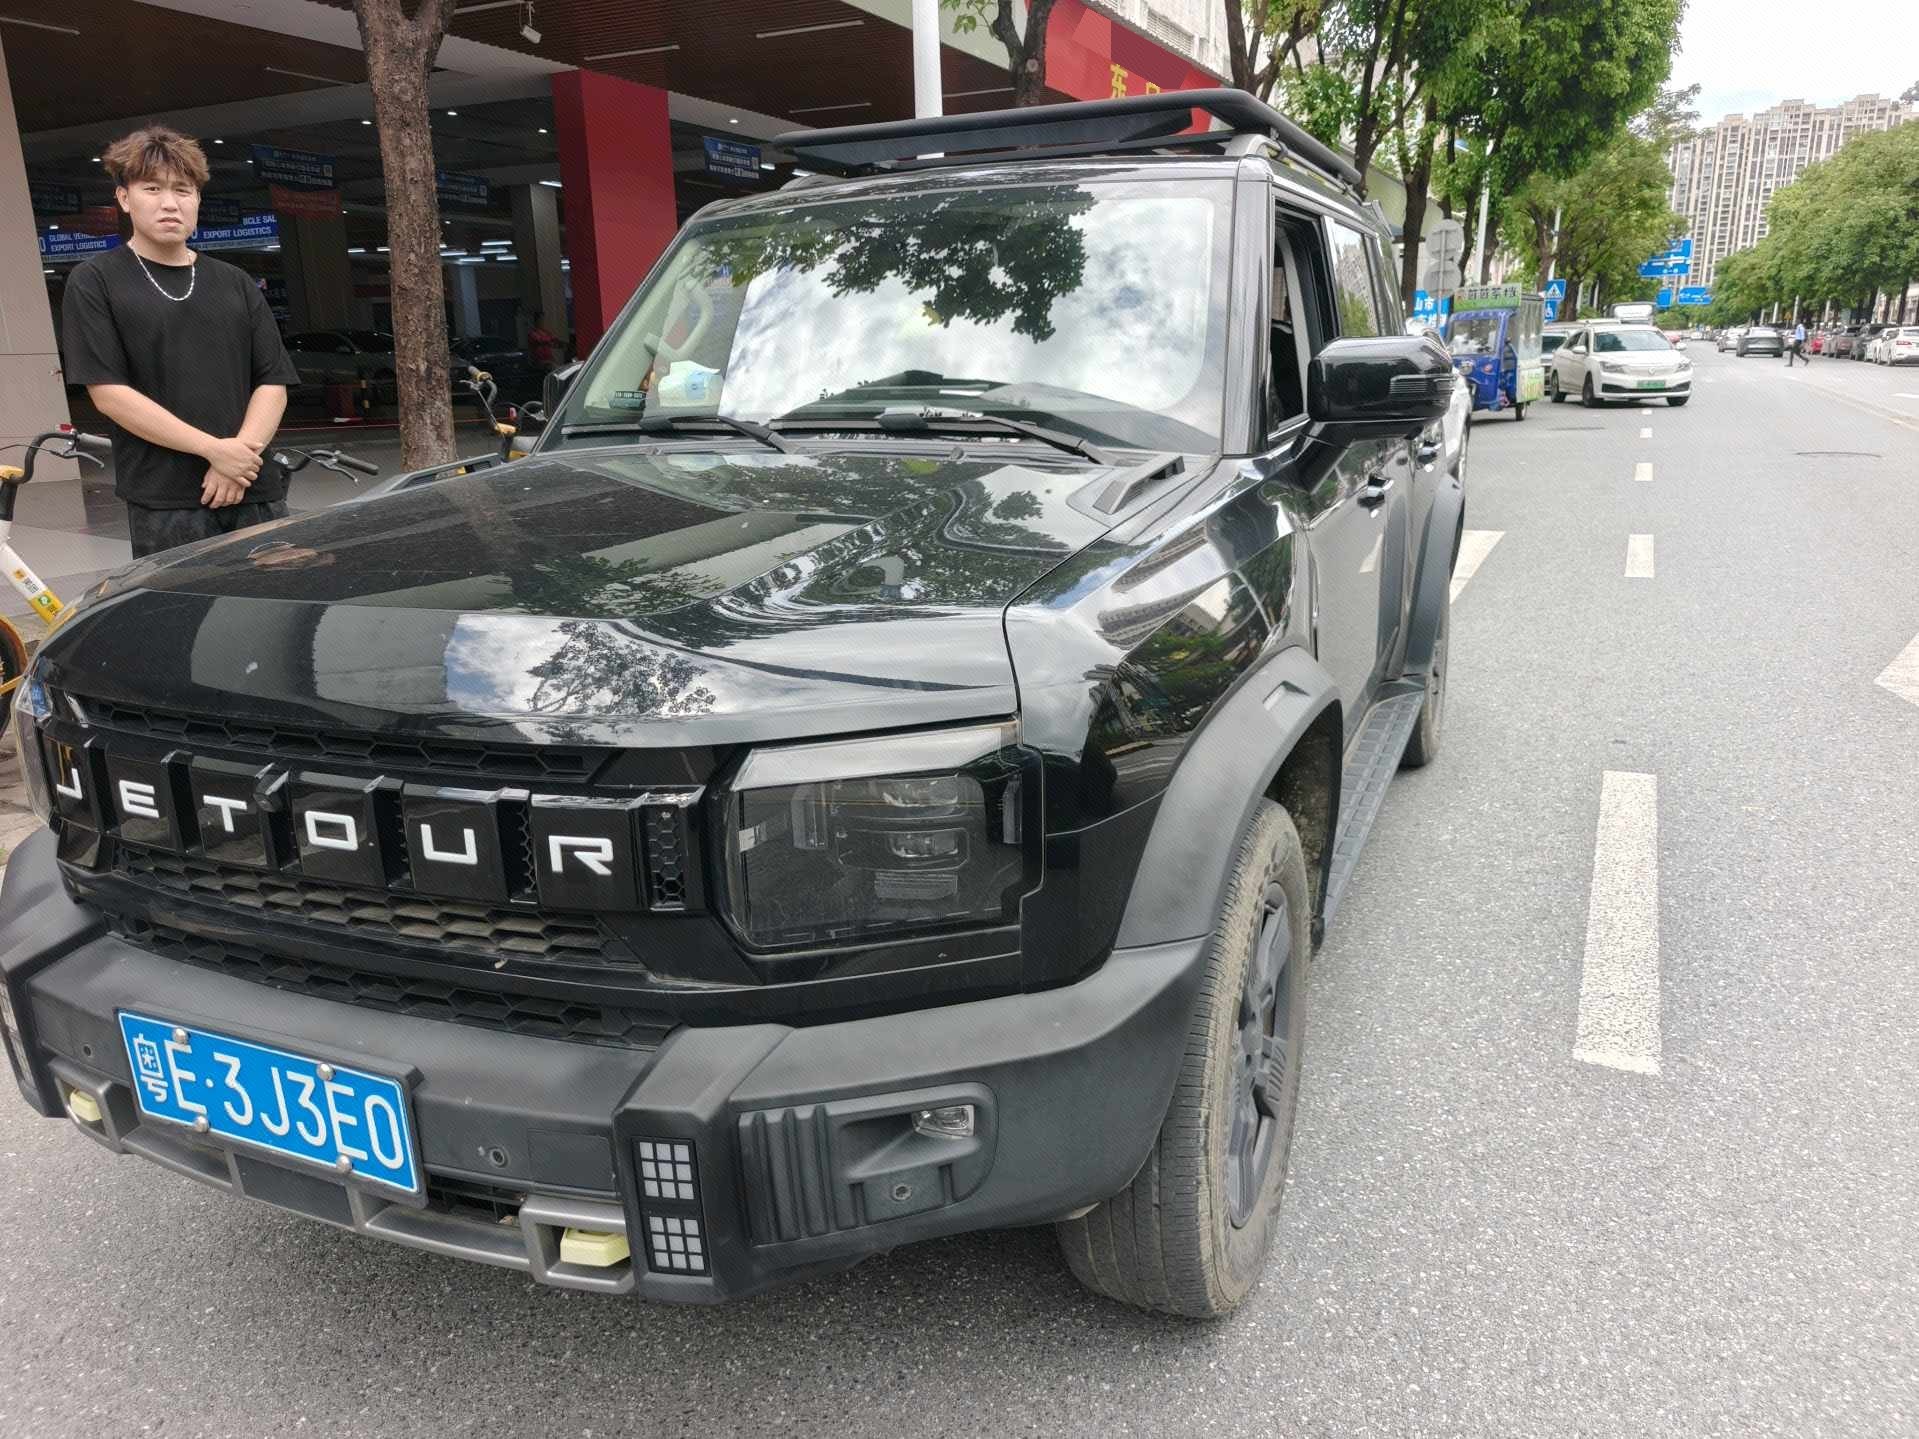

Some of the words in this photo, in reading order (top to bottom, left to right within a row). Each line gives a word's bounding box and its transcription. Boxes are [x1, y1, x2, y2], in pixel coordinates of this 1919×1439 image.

[203, 229, 231, 239] EXPORT
[233, 226, 272, 238] LOGISTICS
[50, 243, 74, 252] EXPORT
[56, 768, 614, 876] JETOUR
